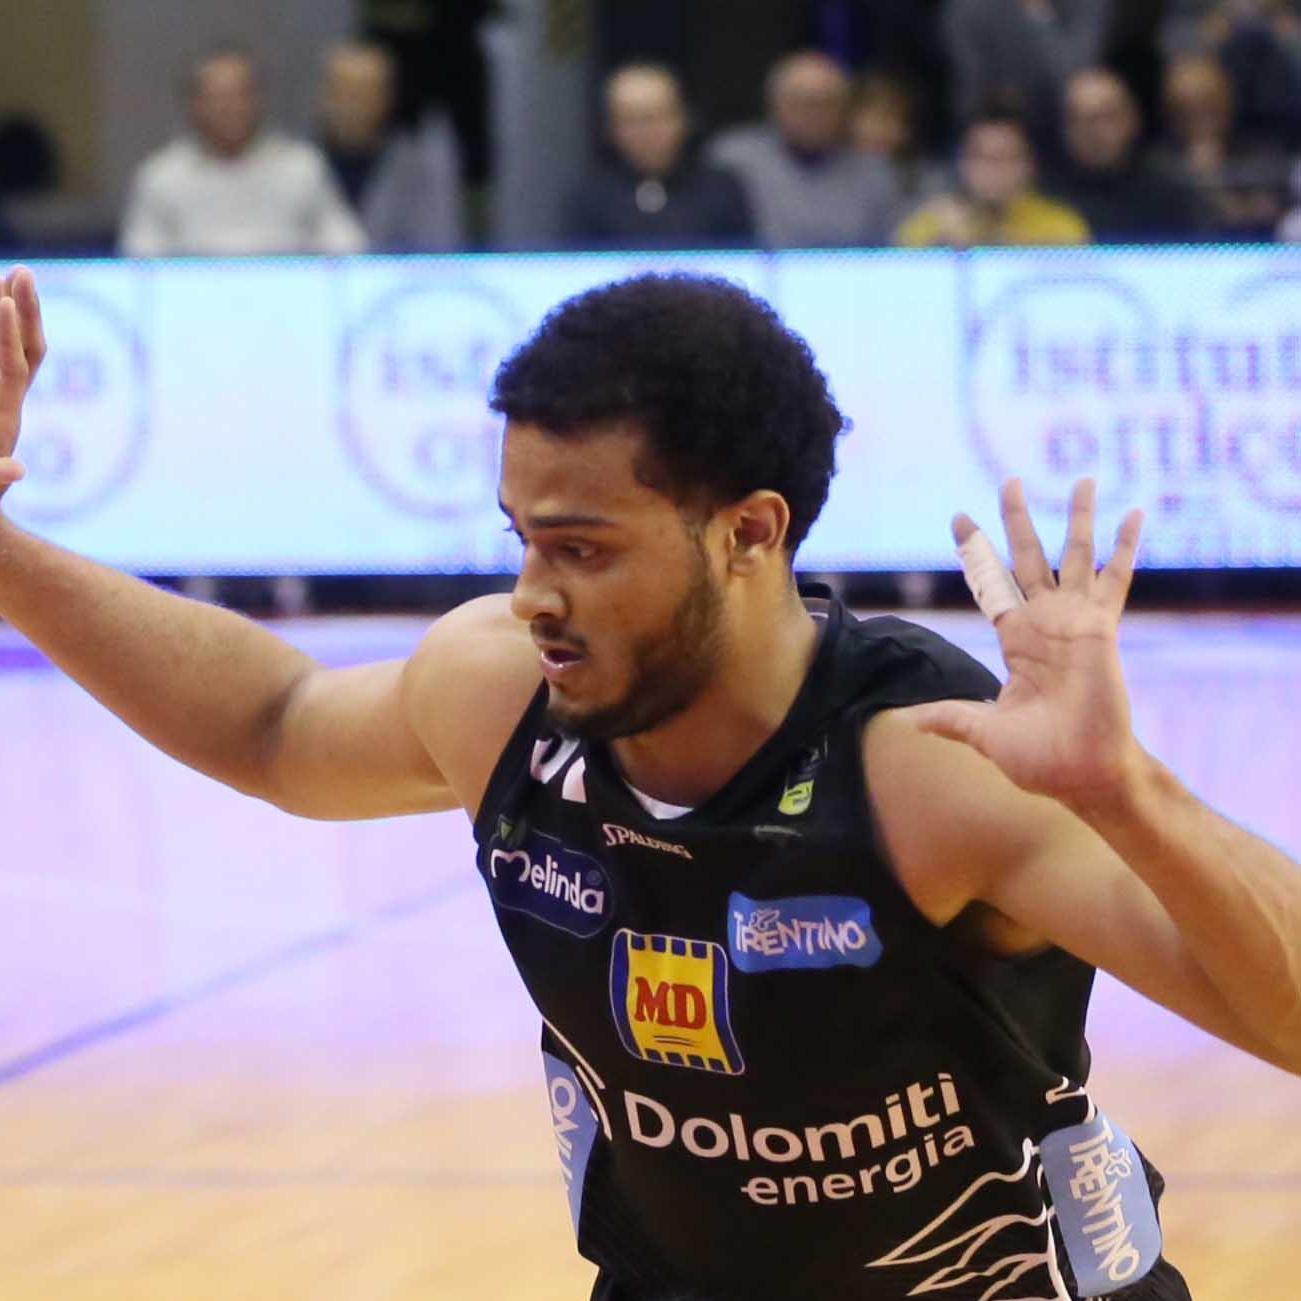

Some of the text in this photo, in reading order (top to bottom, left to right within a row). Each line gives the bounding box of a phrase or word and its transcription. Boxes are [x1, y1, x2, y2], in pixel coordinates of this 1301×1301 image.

[602, 823, 694, 860] SPALDING
[490, 848, 606, 914] Melinda
[734, 908, 867, 955] TRENTINO
[634, 976, 707, 1031] MD
[624, 1073, 961, 1164] Dolomiti
[742, 1120, 977, 1206] energia
[1068, 1118, 1140, 1281] TRENTINO
